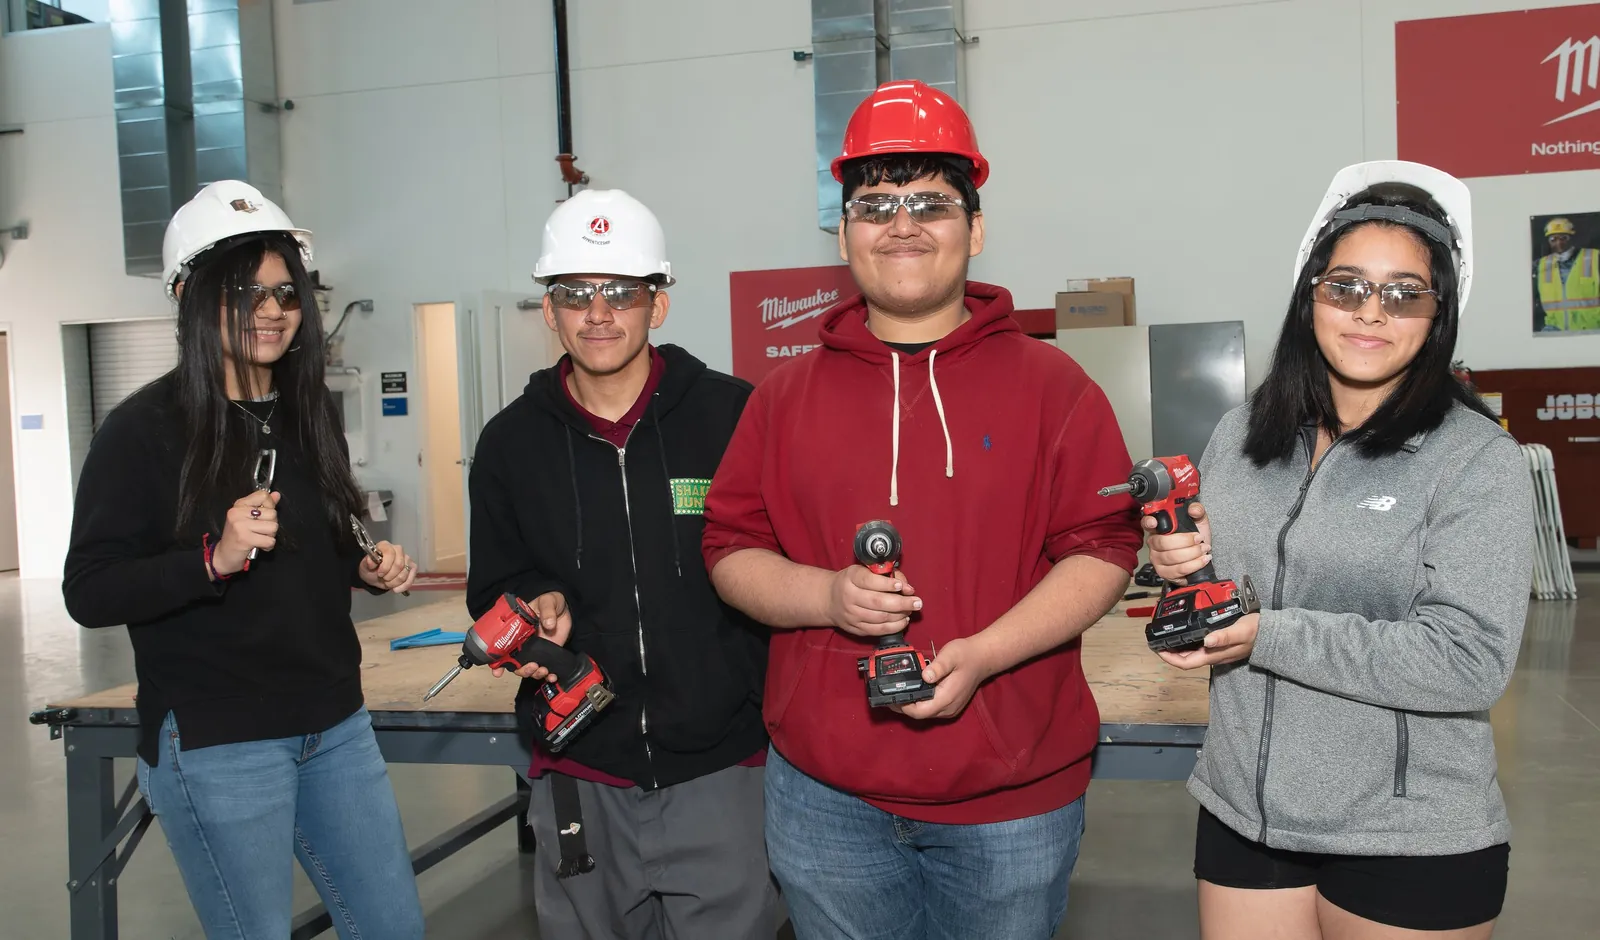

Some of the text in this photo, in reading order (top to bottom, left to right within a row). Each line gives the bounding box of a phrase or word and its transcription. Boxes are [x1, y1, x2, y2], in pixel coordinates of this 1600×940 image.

[1531, 140, 1600, 155] Nothing
[757, 289, 839, 323] Milwaukee
[1537, 393, 1600, 420] JOB
[677, 497, 705, 508] JUN
[494, 619, 520, 649] Milwaukee
